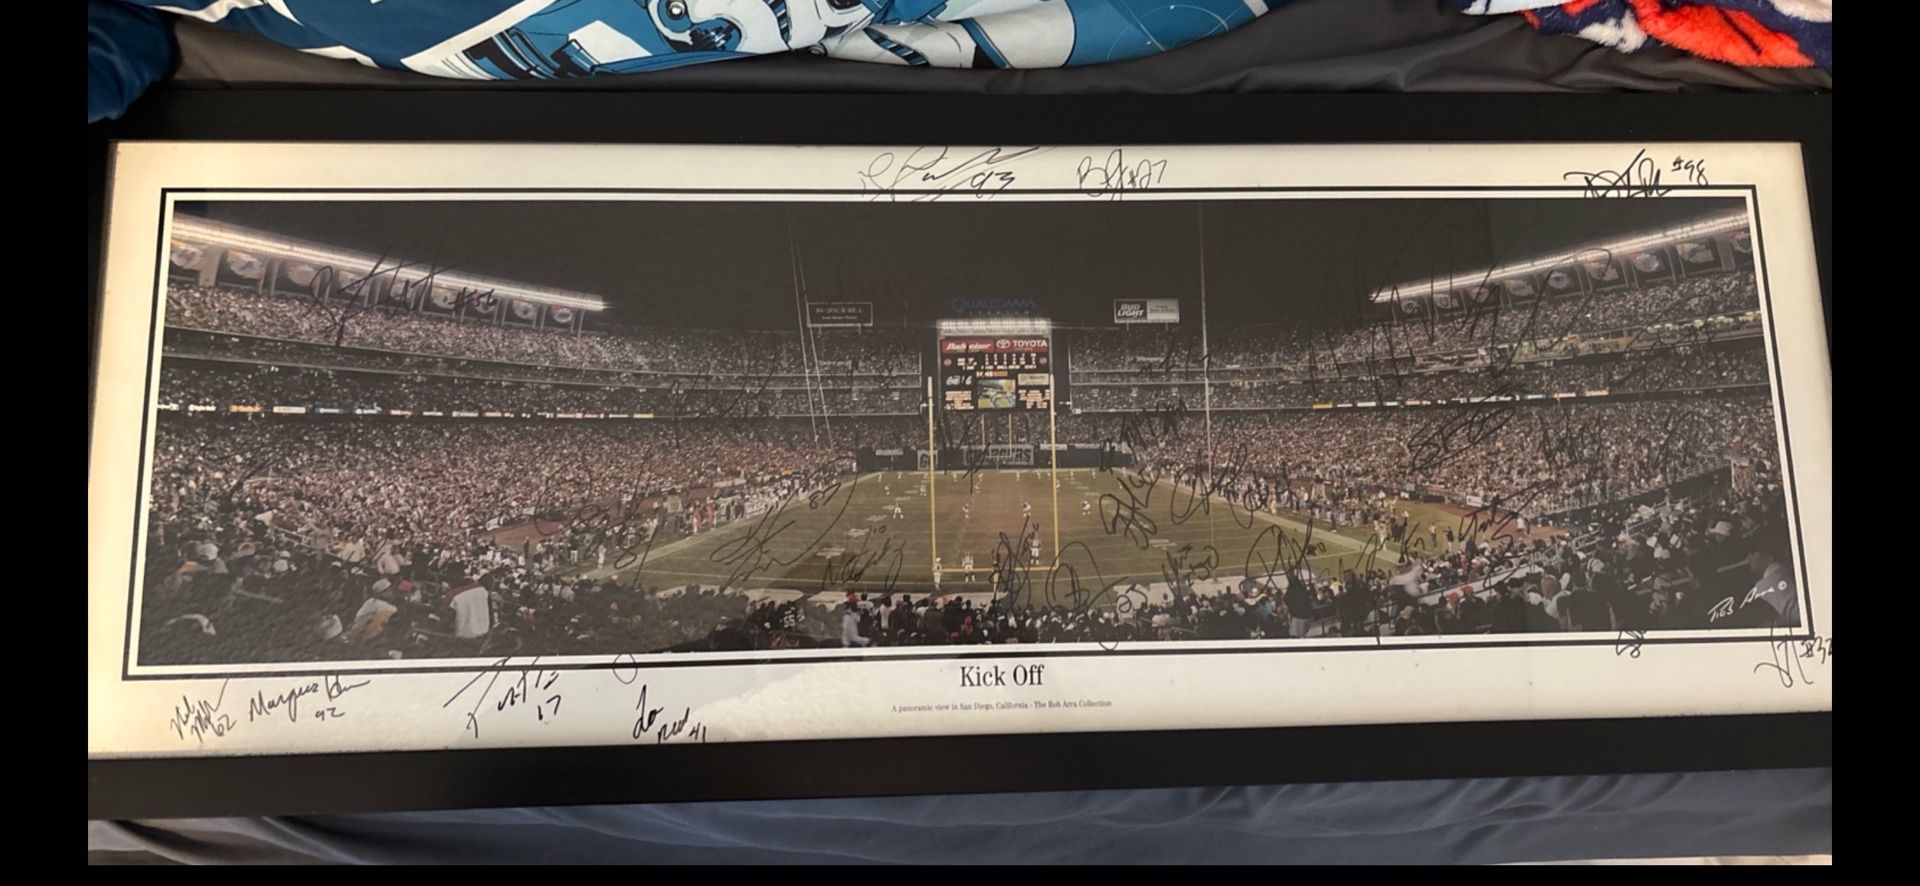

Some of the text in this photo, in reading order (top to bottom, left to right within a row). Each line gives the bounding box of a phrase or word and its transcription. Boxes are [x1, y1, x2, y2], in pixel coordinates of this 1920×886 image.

[1117, 309, 1145, 317] LIGHT
[1012, 340, 1048, 348] TOYOTA
[959, 663, 1046, 688] Kick Off
[898, 703, 934, 714] panoramic
[935, 703, 950, 712] view
[951, 702, 959, 711] in
[960, 702, 973, 711] San
[974, 701, 995, 712] Diego,
[996, 700, 1029, 710] California
[1034, 700, 1047, 709] The
[1079, 698, 1113, 708] Collection
